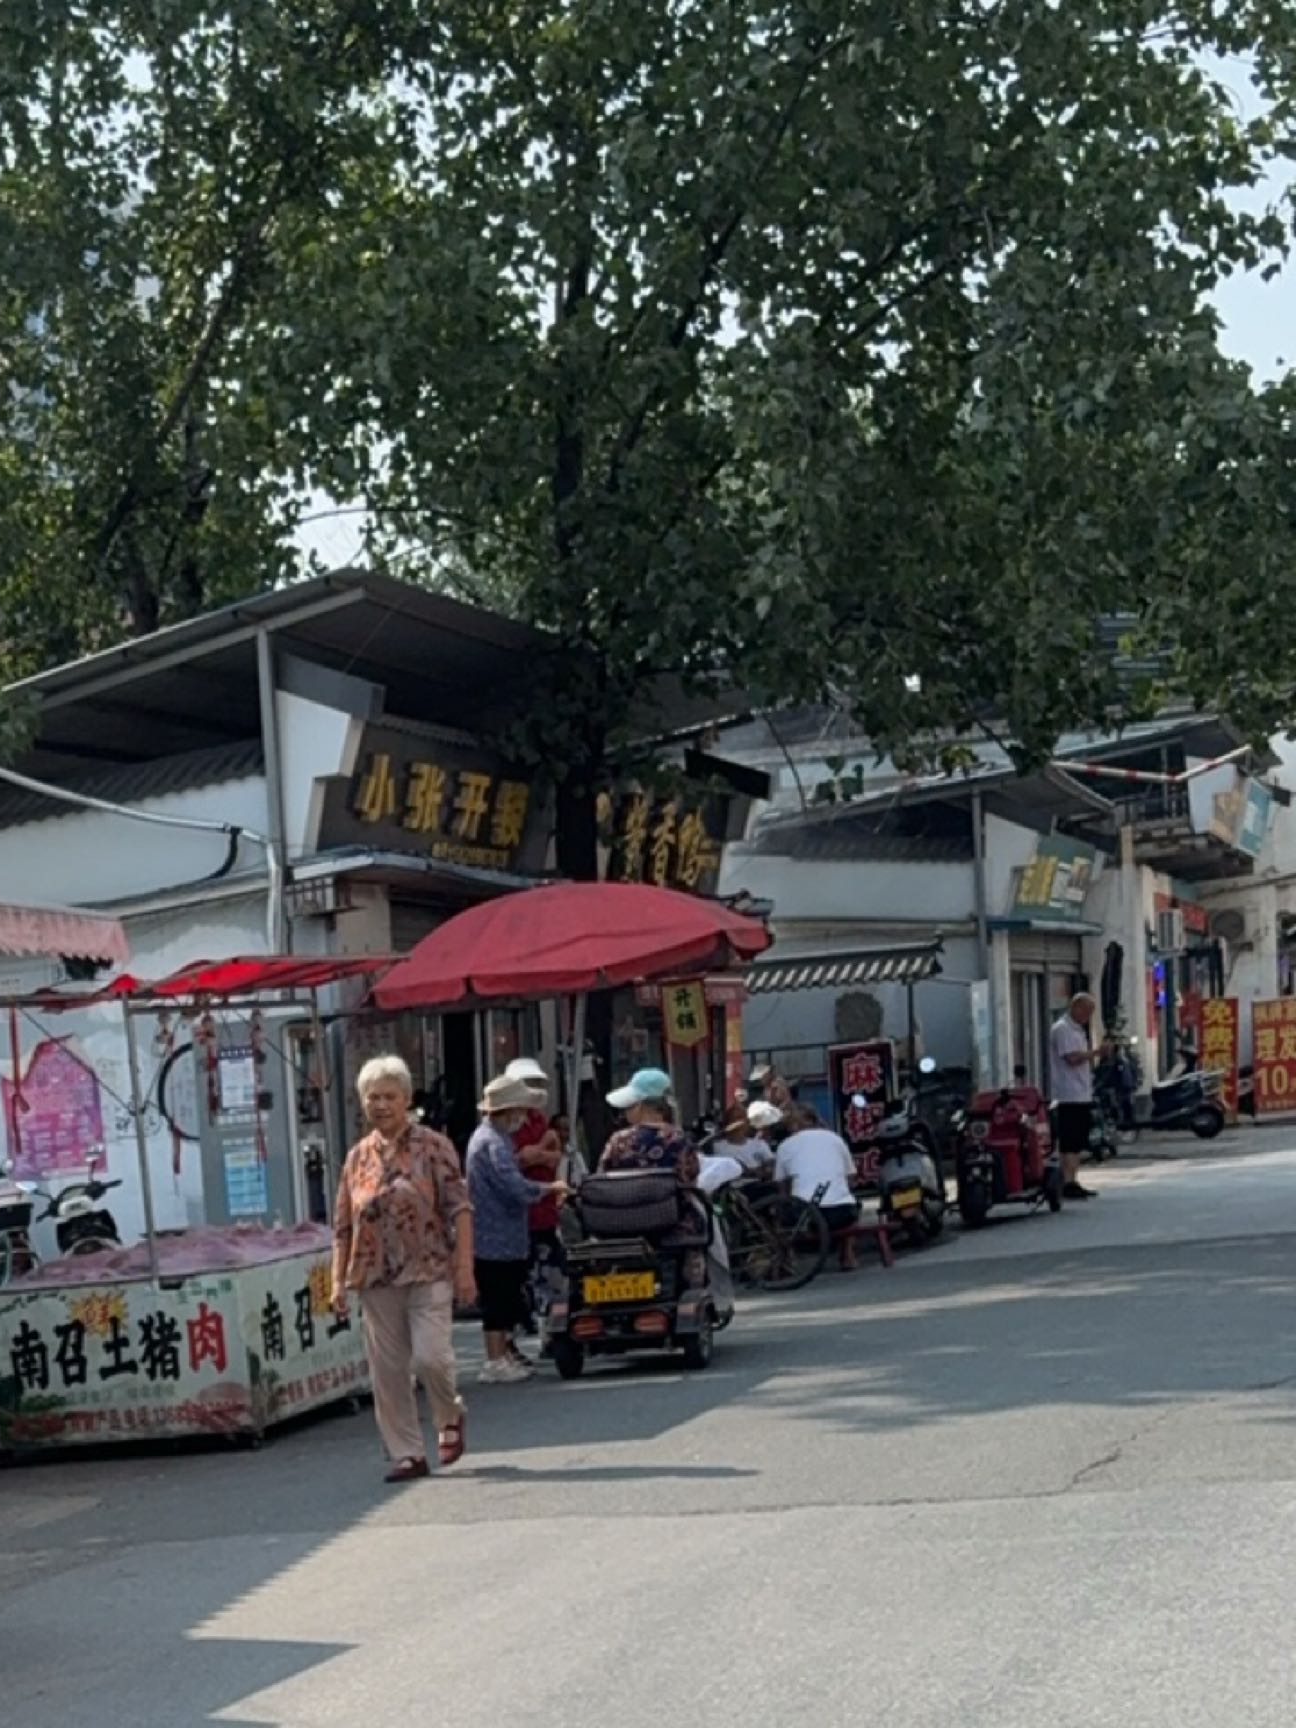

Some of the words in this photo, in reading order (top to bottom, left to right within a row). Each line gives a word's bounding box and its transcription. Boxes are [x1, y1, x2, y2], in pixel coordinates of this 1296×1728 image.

[9, 1302, 228, 1390] 南召土猪肉
